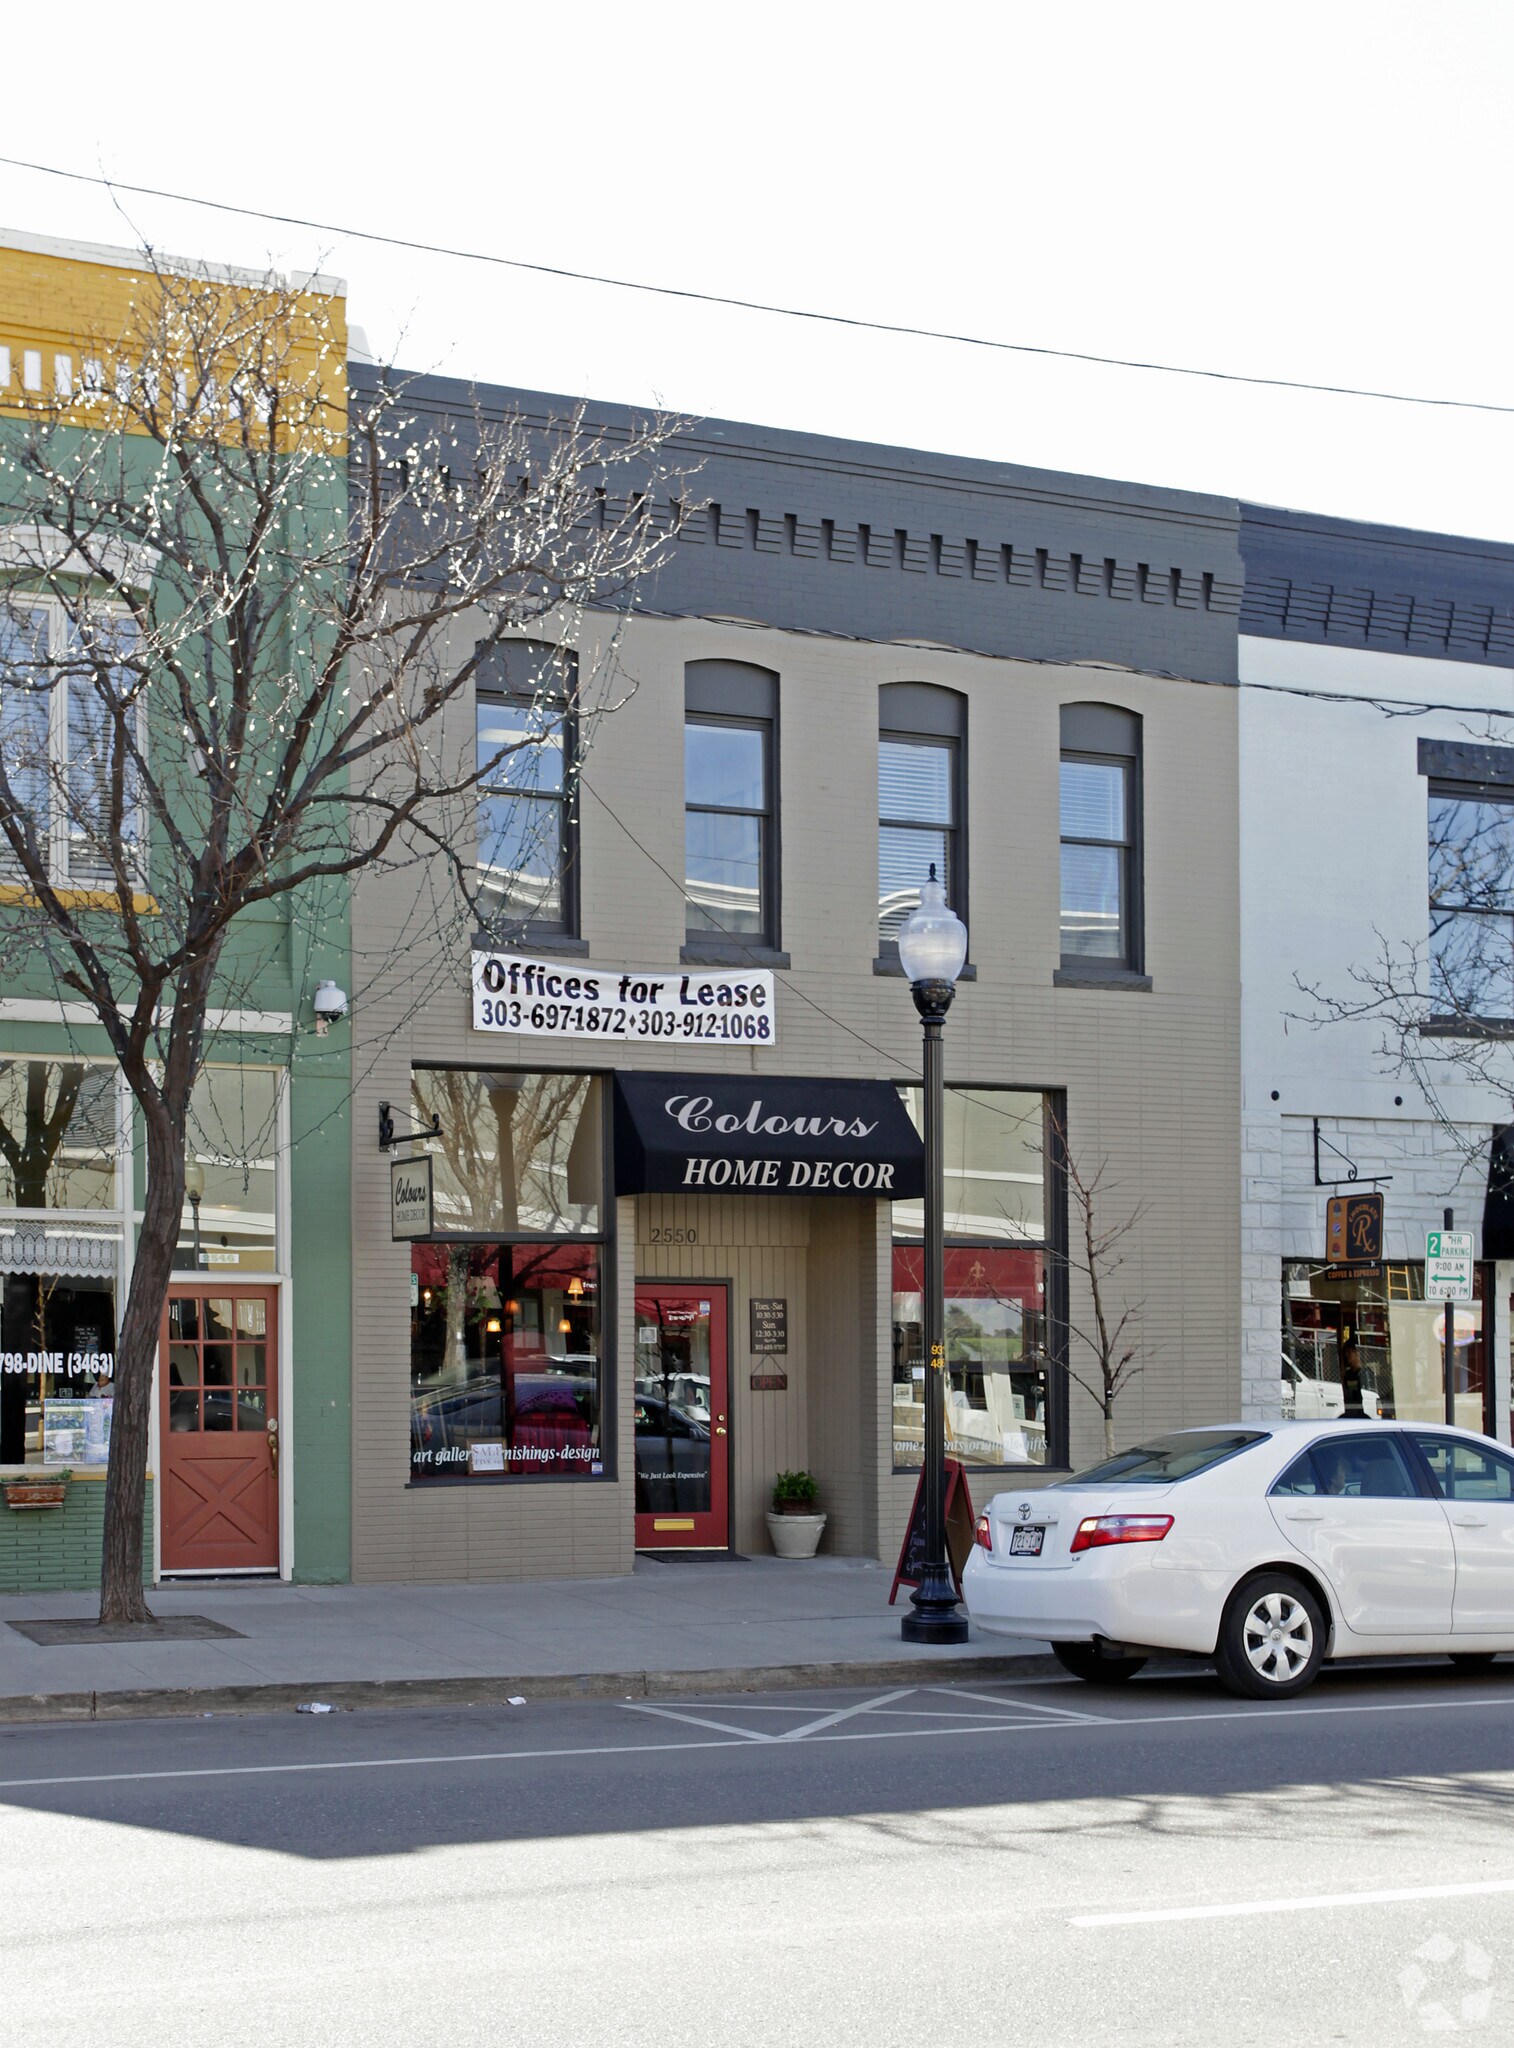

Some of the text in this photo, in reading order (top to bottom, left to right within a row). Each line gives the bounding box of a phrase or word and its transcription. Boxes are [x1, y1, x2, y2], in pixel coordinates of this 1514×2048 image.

[482, 959, 767, 1007] Offices for Lease
[664, 1095, 879, 1137] Colours
[682, 1158, 895, 1189] HOME DECOR
[395, 1177, 427, 1206] Colours
[396, 1208, 426, 1222] HOME DECOR
[651, 1228, 697, 1244] 2550
[1429, 1236, 1462, 1254] 2 HR
[1441, 1247, 1469, 1257] PARKING
[1327, 1270, 1347, 1279] COFFEE
[1354, 1268, 1380, 1278] ESPRESSO
[1435, 1262, 1464, 1272] 9:00 AM
[1428, 1285, 1468, 1295] TO 6:00 PM
[67, 1352, 114, 1378] (3463)
[752, 1376, 786, 1389] OPEN
[894, 1440, 919, 1452] ome
[413, 1449, 432, 1463] art
[435, 1446, 472, 1466] galler
[650, 1472, 661, 1480] Just
